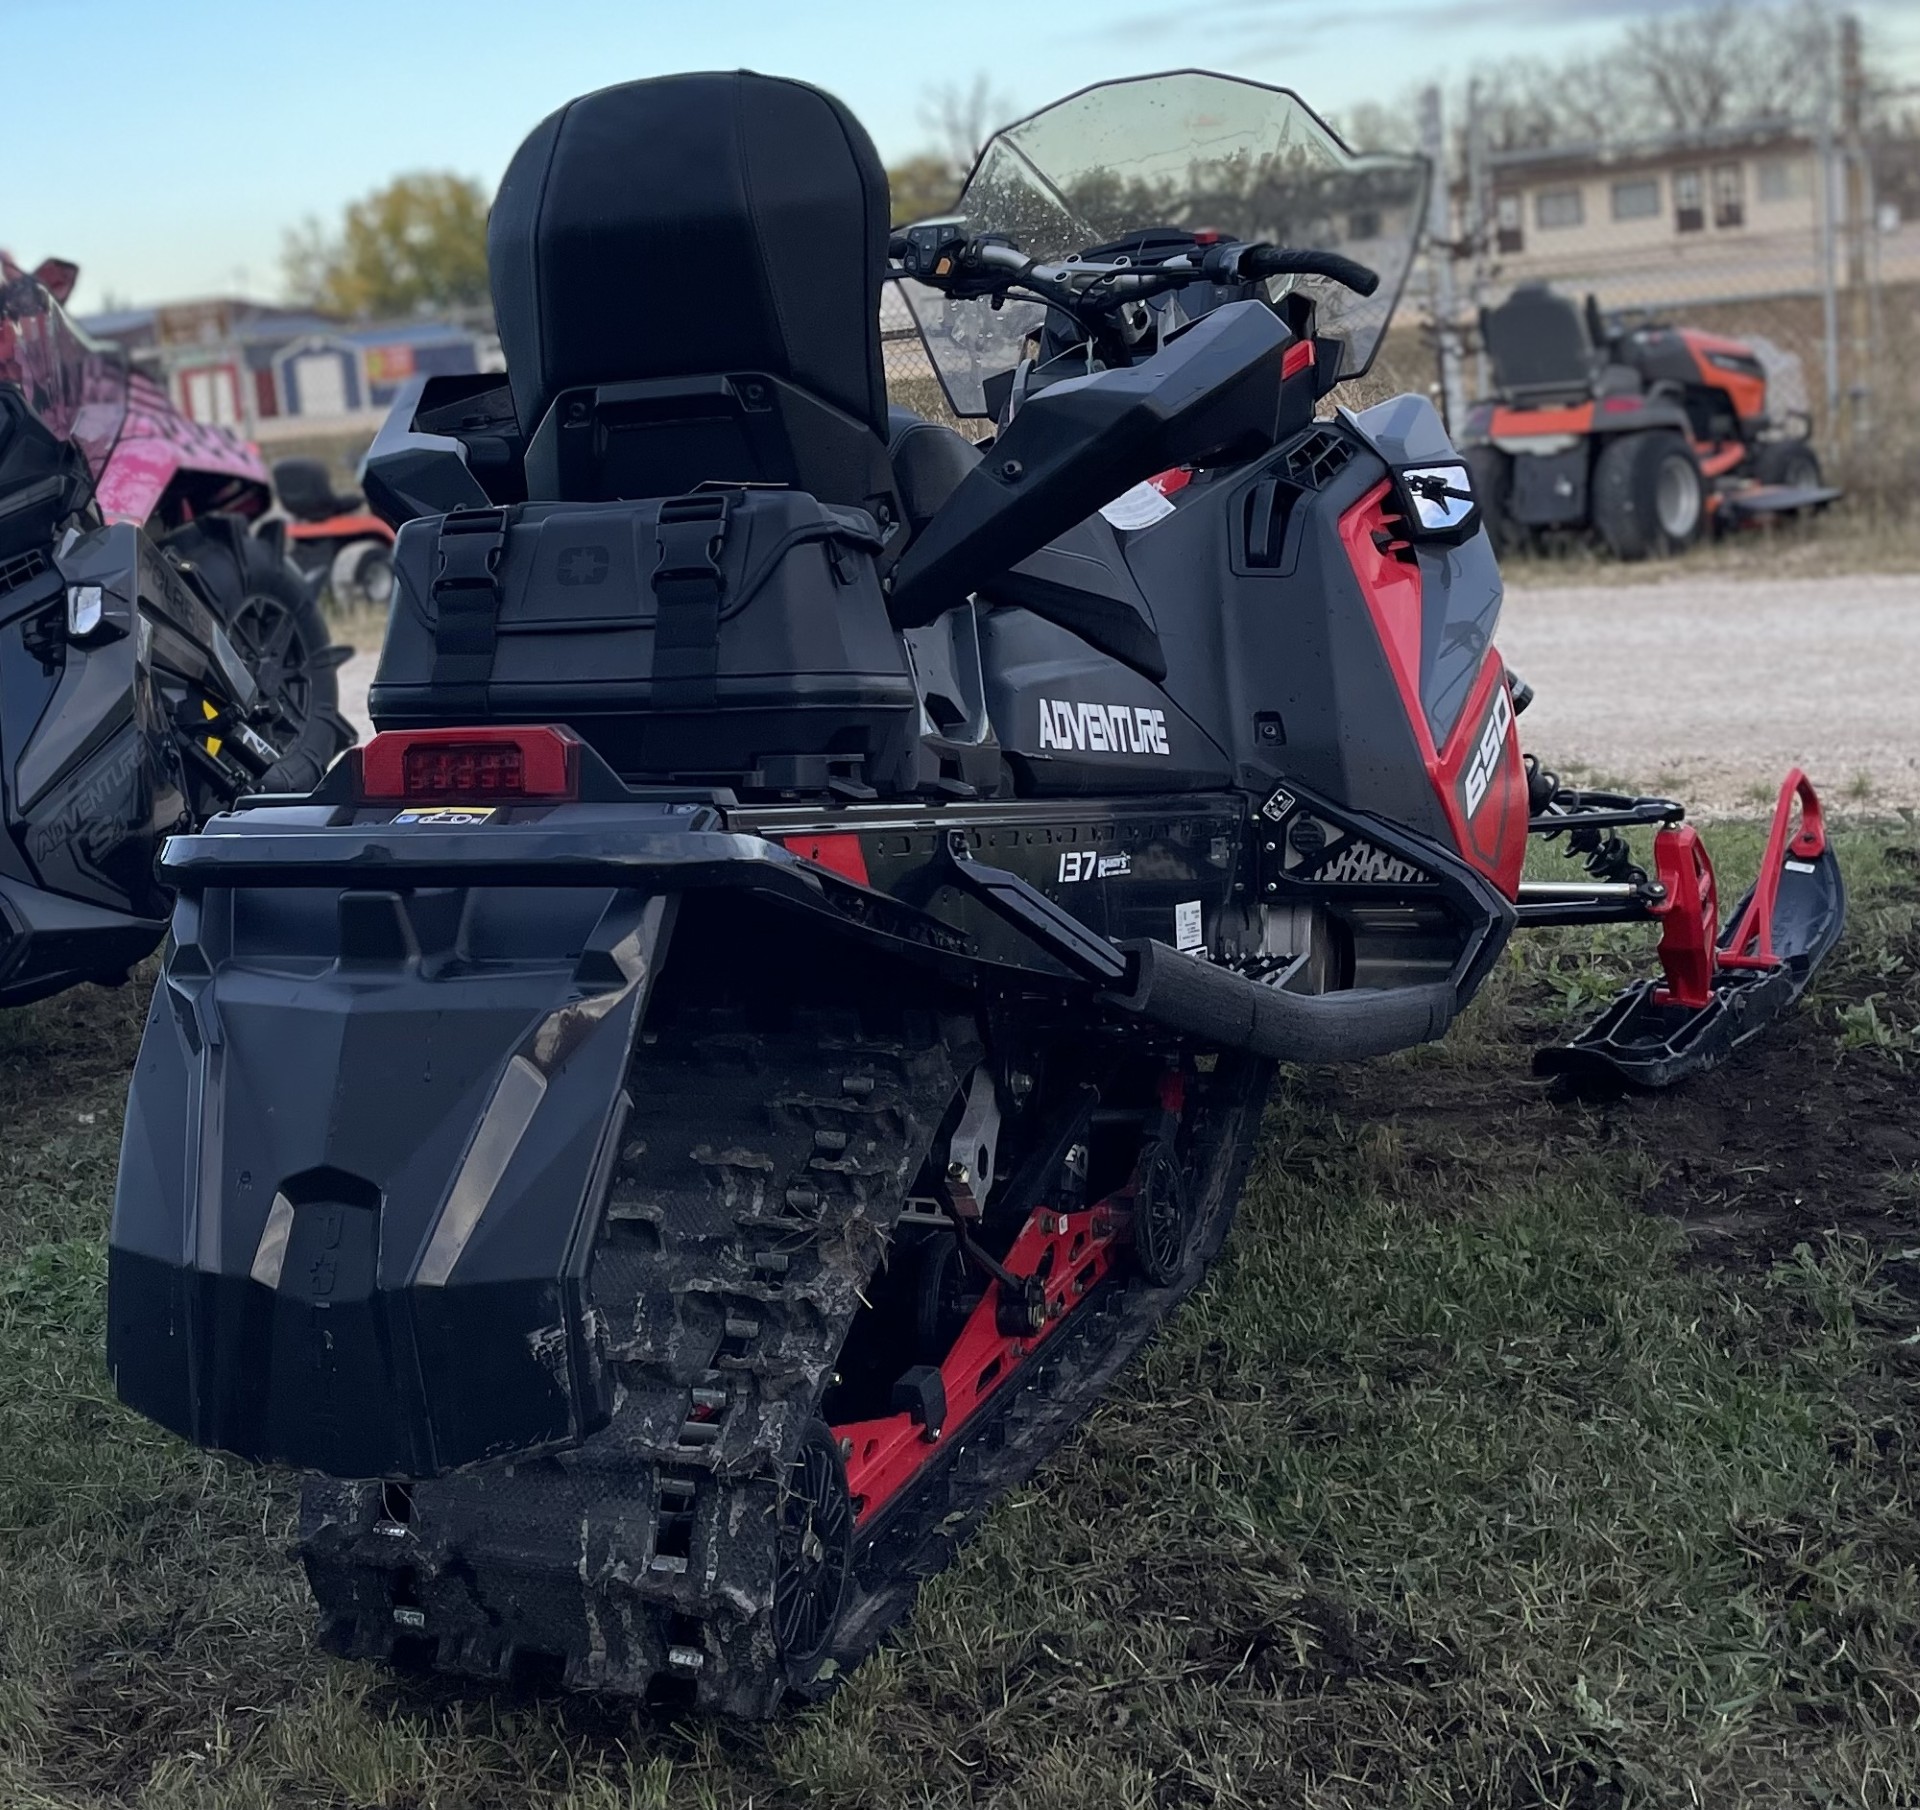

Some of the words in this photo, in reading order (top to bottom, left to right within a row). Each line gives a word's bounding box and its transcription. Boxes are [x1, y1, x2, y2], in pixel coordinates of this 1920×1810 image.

[1039, 698, 1170, 756] ADVENTURE
[1464, 684, 1512, 820] 650
[37, 731, 147, 863] ADVENTURE
[1057, 851, 1097, 883] 137
